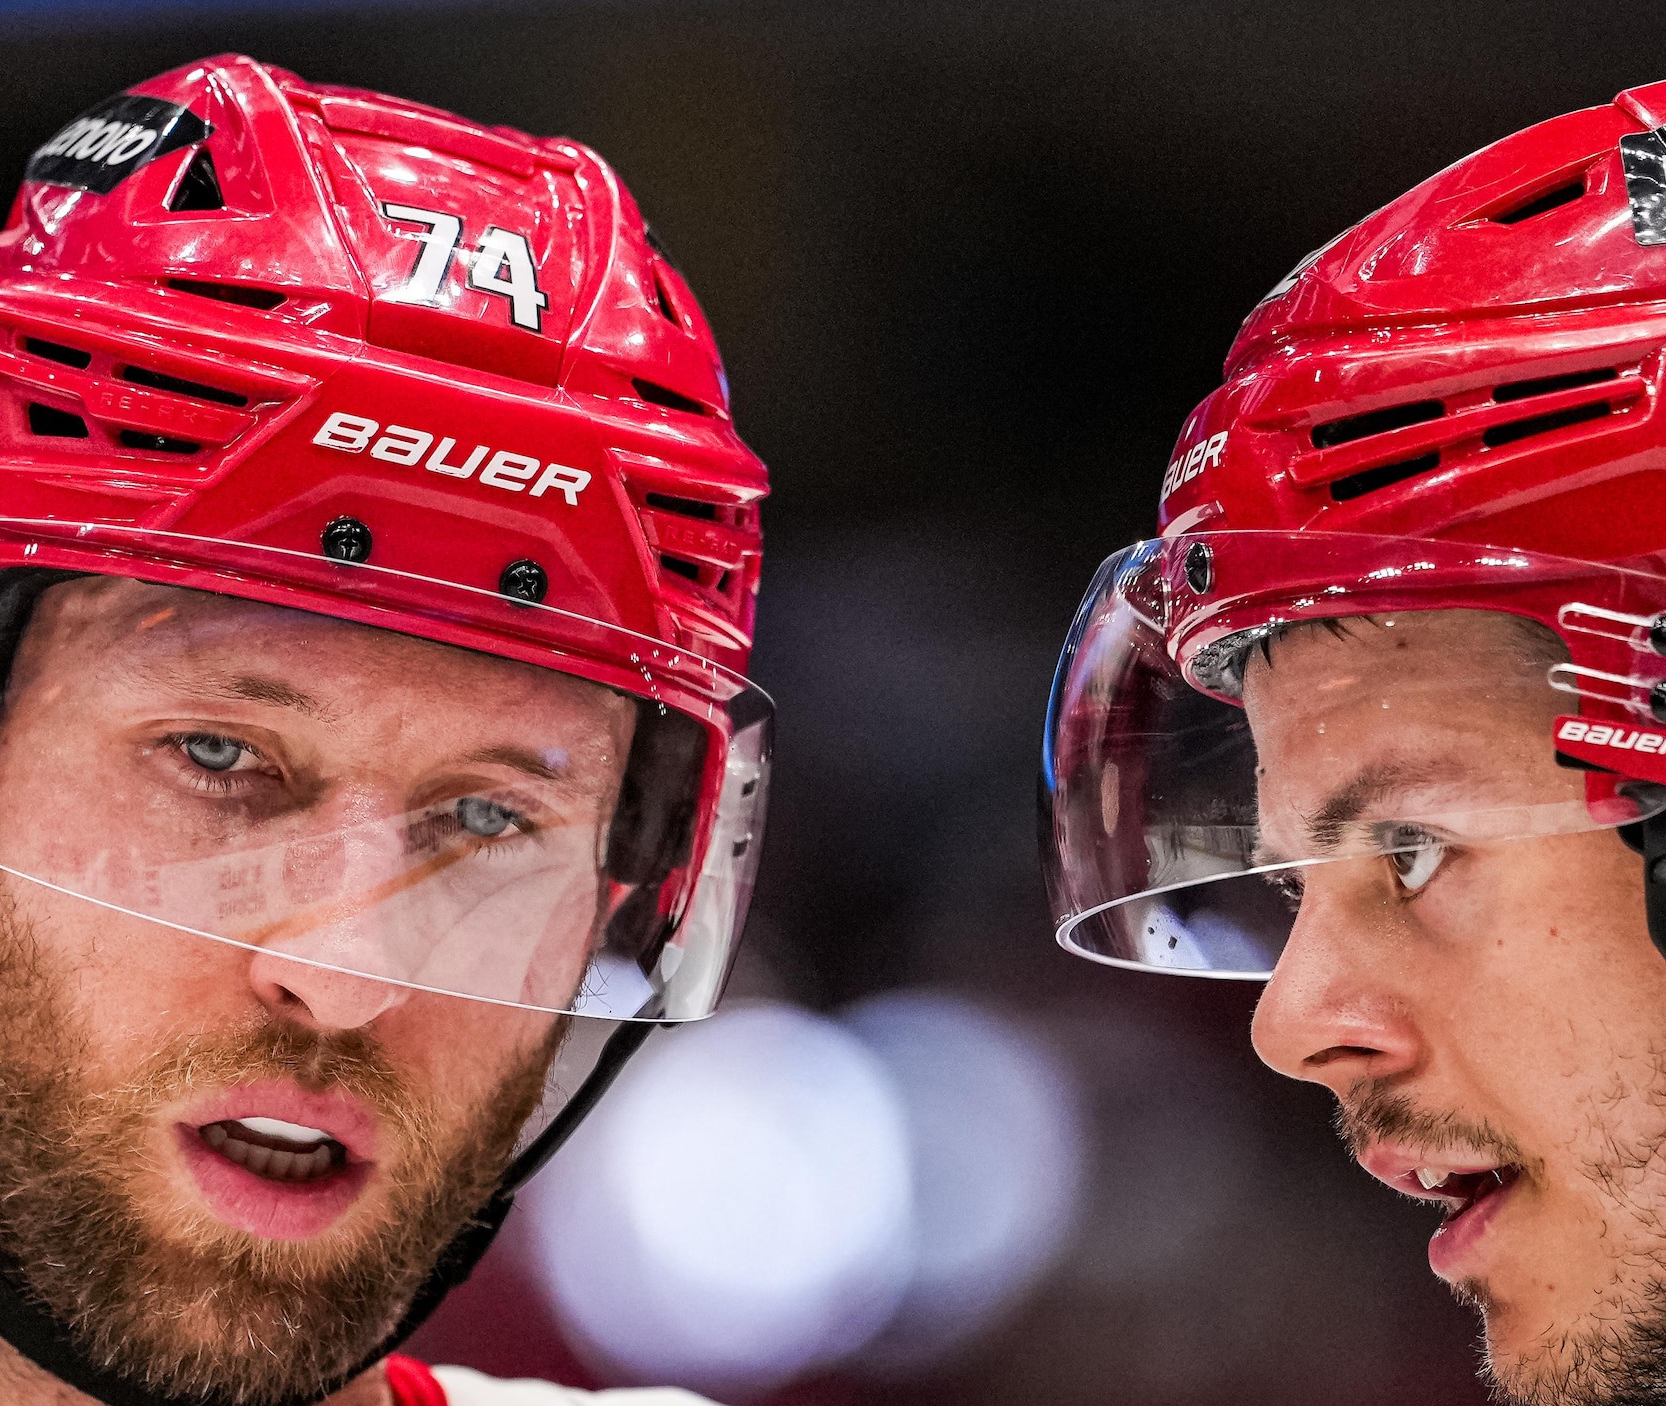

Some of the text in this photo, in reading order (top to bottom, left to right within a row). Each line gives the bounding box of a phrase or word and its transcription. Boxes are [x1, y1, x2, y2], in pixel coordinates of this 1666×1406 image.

[34, 116, 158, 166] enovo
[380, 201, 550, 334] 74
[1160, 430, 1229, 504] AUER
